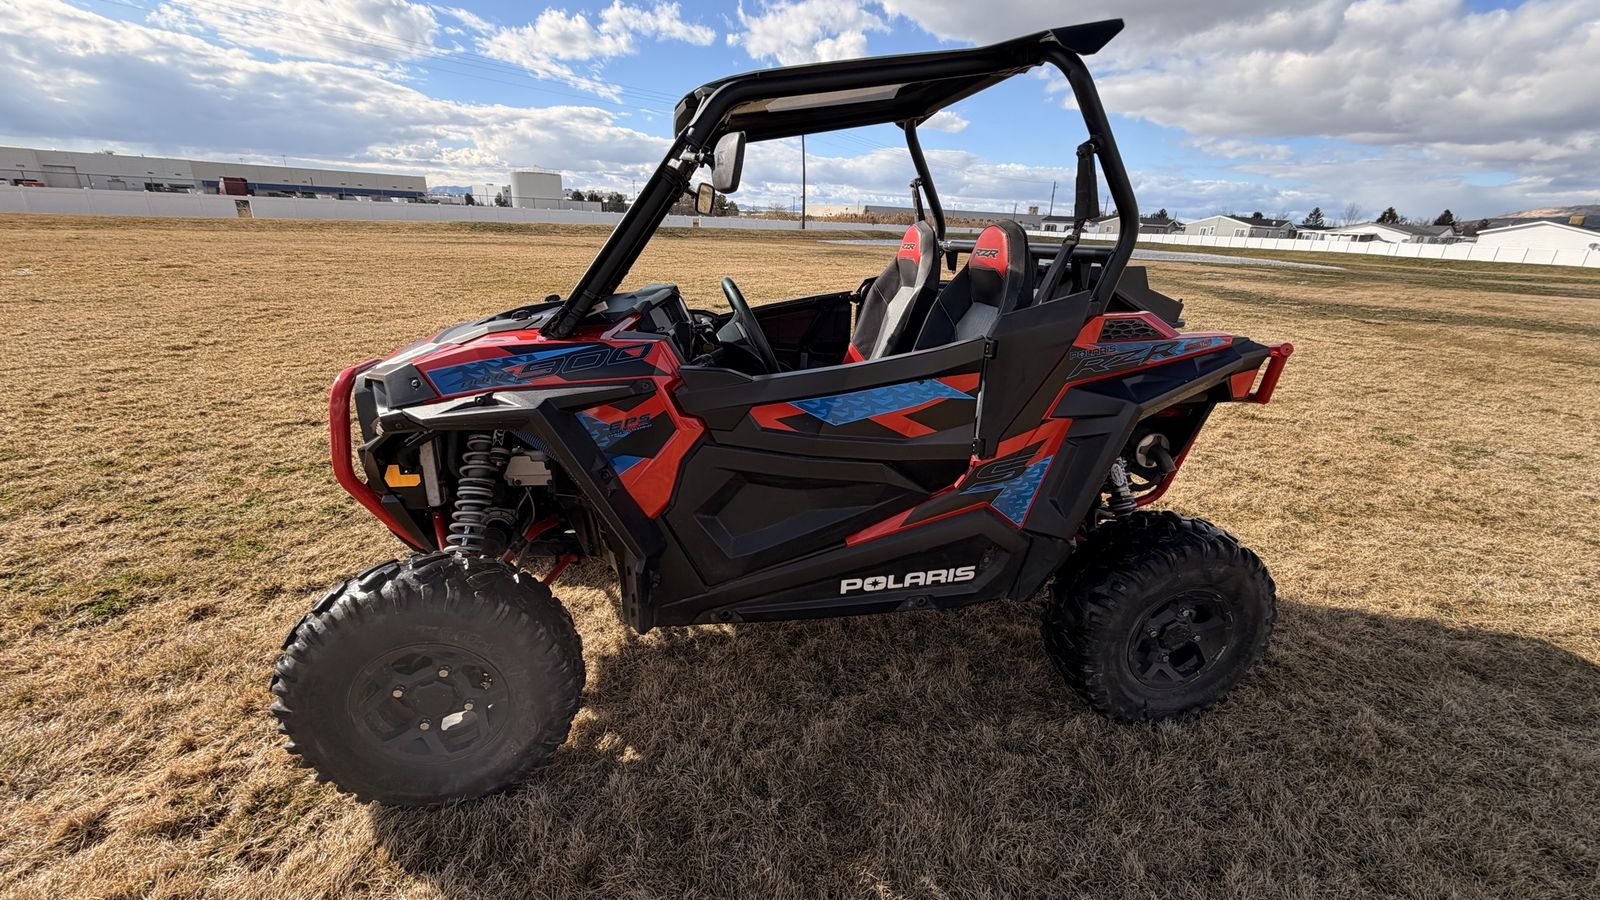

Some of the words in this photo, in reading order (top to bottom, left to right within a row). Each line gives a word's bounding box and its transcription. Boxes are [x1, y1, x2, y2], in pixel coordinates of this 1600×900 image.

[975, 248, 999, 258] RZR
[516, 344, 653, 379] 900
[1066, 340, 1180, 380] RZR
[1069, 344, 1118, 361] POLARIS
[609, 413, 651, 431] EPS
[839, 565, 977, 595] POLARIS
